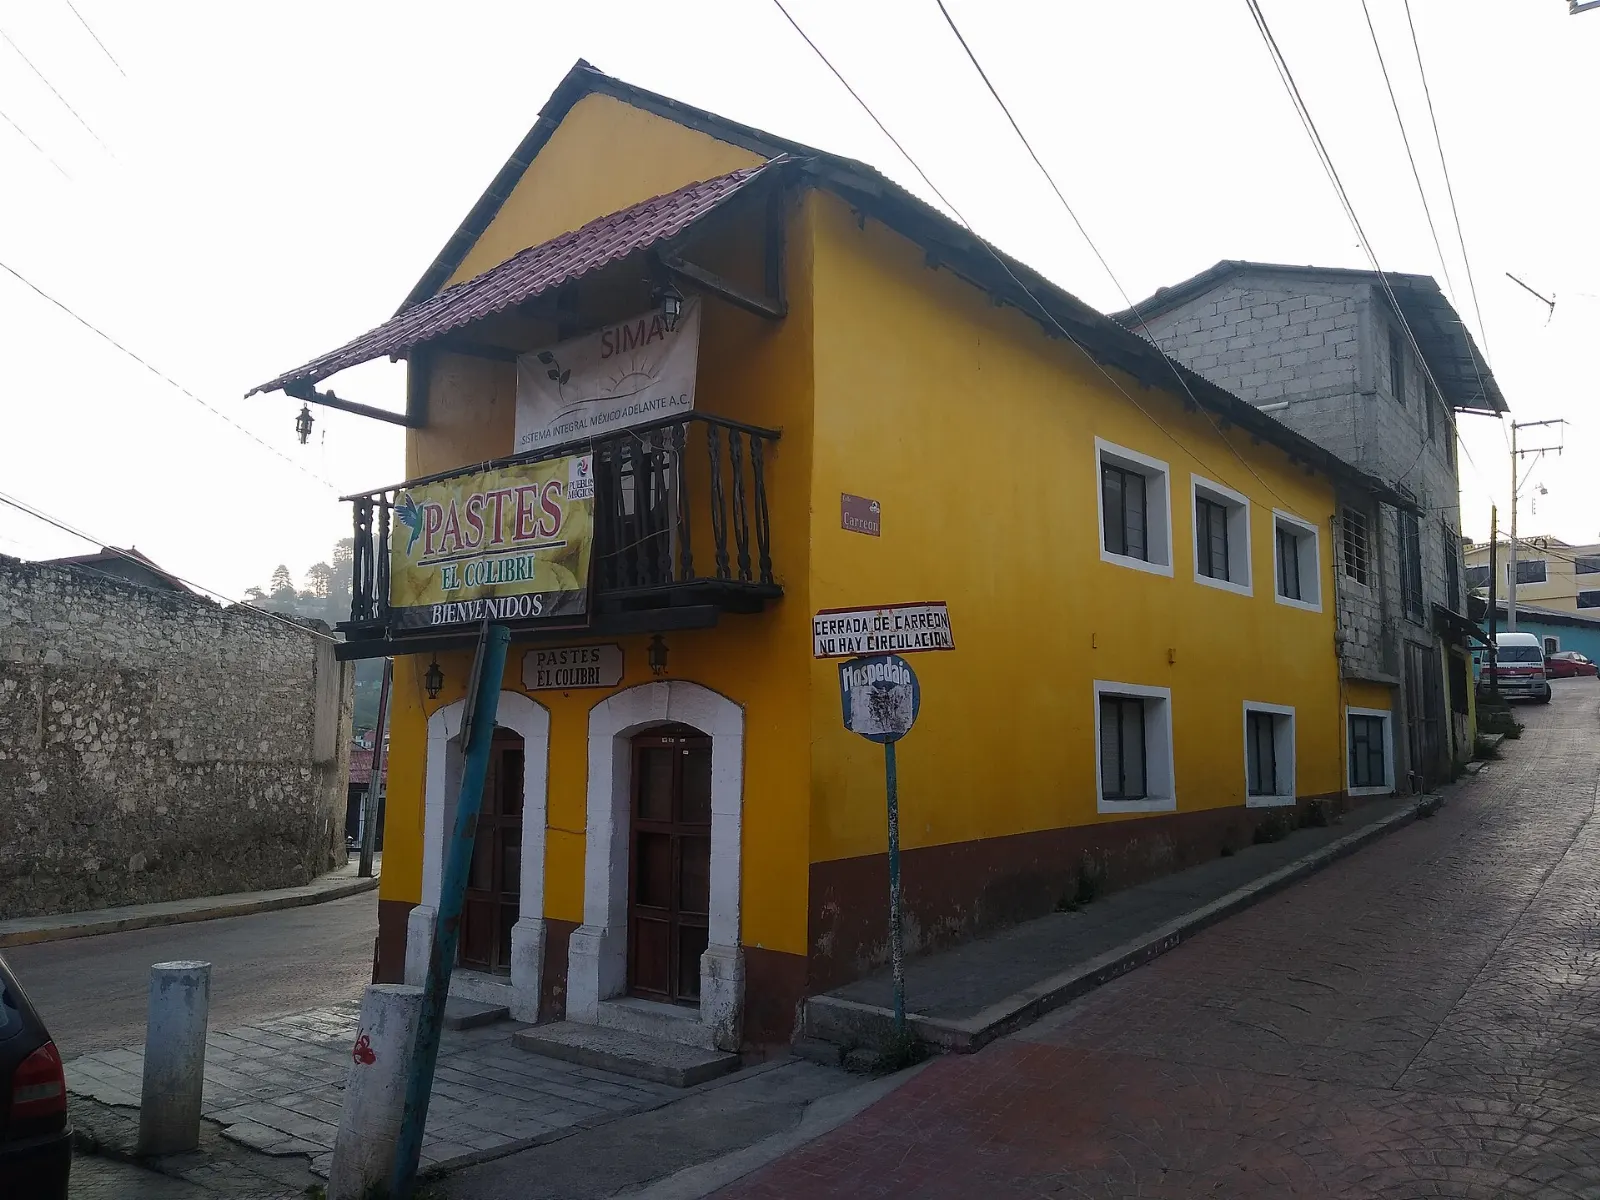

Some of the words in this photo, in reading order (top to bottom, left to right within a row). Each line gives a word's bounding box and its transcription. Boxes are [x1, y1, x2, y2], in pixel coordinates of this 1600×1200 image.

[601, 314, 664, 359] SIMA
[521, 428, 551, 445] SISTEMA
[552, 416, 588, 437] INTEGRAL
[589, 407, 620, 426] MÉXICO
[621, 397, 666, 418] ADELANTE
[668, 394, 690, 406] A.C.
[423, 481, 562, 556] PASTES
[441, 565, 459, 590] EL
[464, 555, 535, 588] COLIBRI
[431, 594, 543, 626] BIENVENIDOS
[814, 617, 869, 636] CERRADA
[873, 616, 889, 631] DE
[895, 612, 949, 630] CARREON
[536, 647, 600, 666] PASTES
[820, 638, 835, 654] NO
[839, 636, 861, 653] HAY
[866, 631, 948, 651] CIRCULACION
[536, 669, 552, 687] EL
[555, 666, 600, 686] COLIBRI
